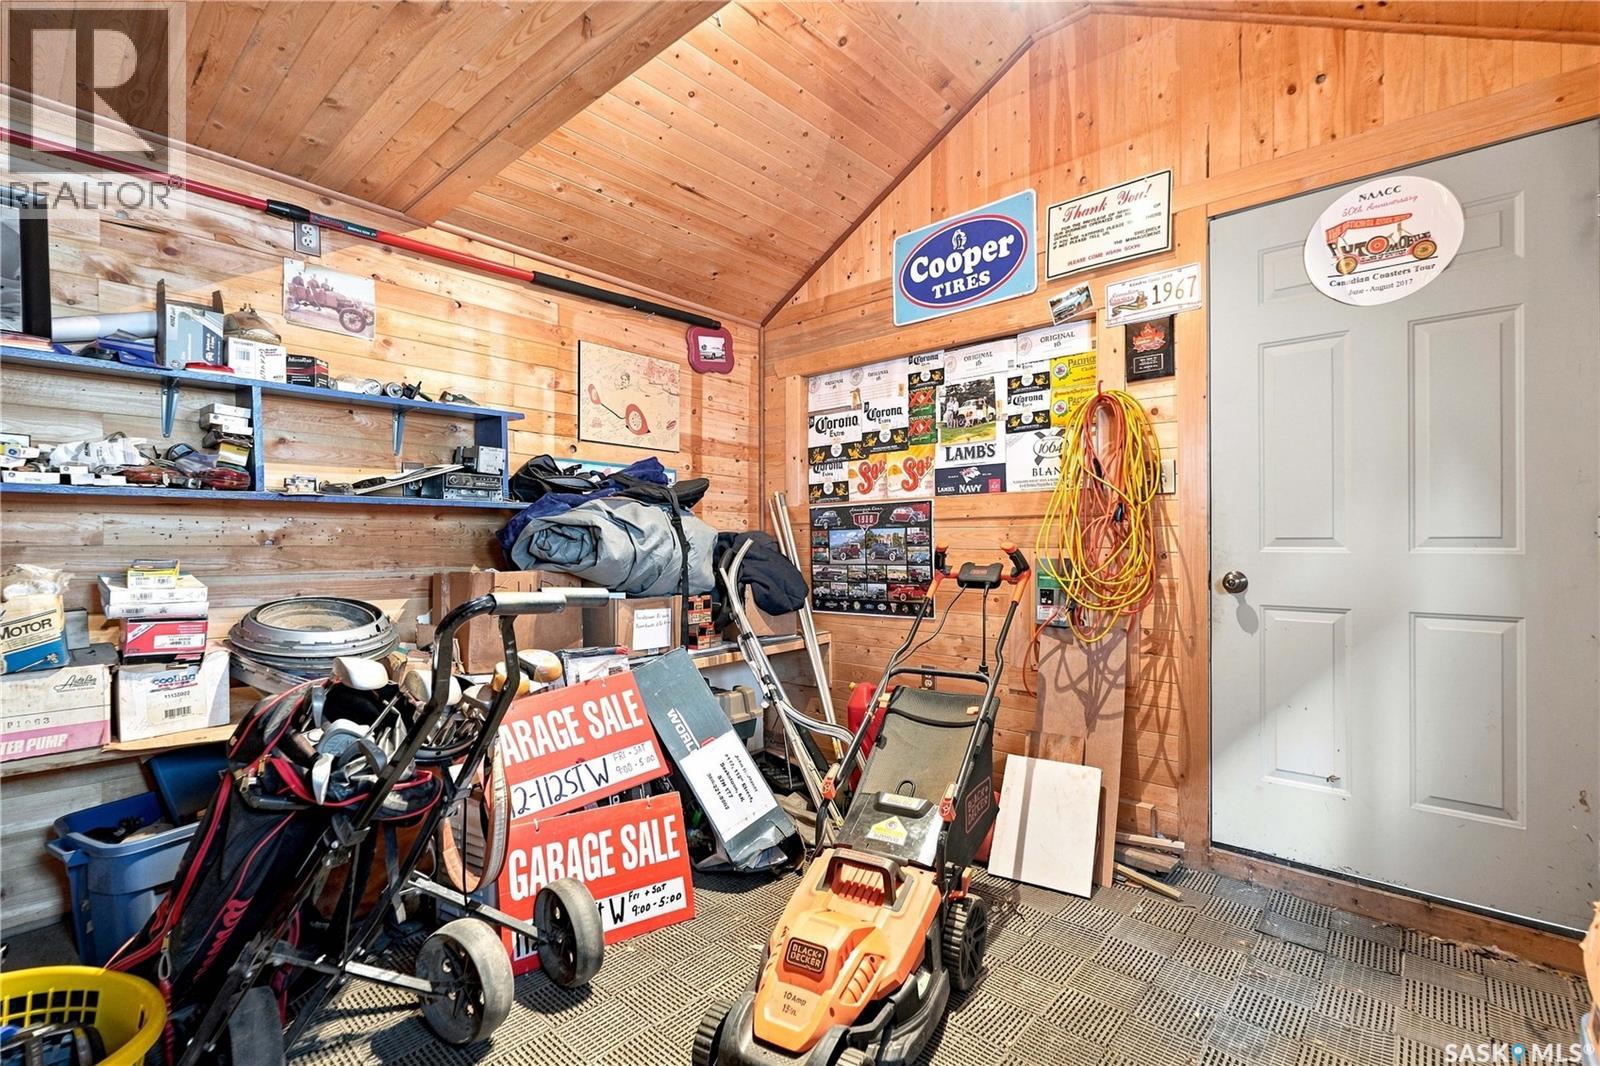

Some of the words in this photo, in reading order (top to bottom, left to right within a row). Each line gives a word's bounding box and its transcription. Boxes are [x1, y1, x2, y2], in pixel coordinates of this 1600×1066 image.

[1062, 197, 1107, 222] Thank
[1117, 184, 1152, 205] You!
[1358, 185, 1401, 202] NAACC
[1366, 196, 1418, 211] Anniversary
[910, 234, 1015, 283] Cooper
[931, 270, 991, 299] TIRES
[1329, 275, 1370, 287] Canadian
[1372, 268, 1411, 280] Coasters
[1413, 263, 1436, 273] Tour
[1152, 275, 1197, 305] 1967
[1369, 282, 1394, 292] August
[1040, 331, 1076, 344] ORIGINAL
[963, 351, 993, 362] ORIGINAL
[1012, 394, 1044, 407] Corona
[866, 405, 903, 422] Corona
[815, 415, 858, 435] Corona
[944, 443, 996, 462] LAMB'S
[857, 460, 887, 495] Sol
[901, 455, 934, 492] Sol
[1032, 467, 1062, 477] BLAN
[959, 484, 982, 493] NAVY
[499, 706, 586, 767] ARAGE
[583, 690, 644, 740] SALE
[667, 708, 698, 752] WORL
[26, 733, 69, 752] PUMP
[613, 751, 626, 761] FRI
[633, 743, 646, 755] SAT
[584, 757, 609, 787] W
[509, 829, 616, 901] GARAGE
[620, 815, 681, 870] SALE
[609, 896, 625, 925] W
[632, 903, 651, 916] 9:00
[658, 892, 682, 907] 5:00
[790, 952, 821, 968] DECKER
[791, 943, 822, 959] BLACK+
